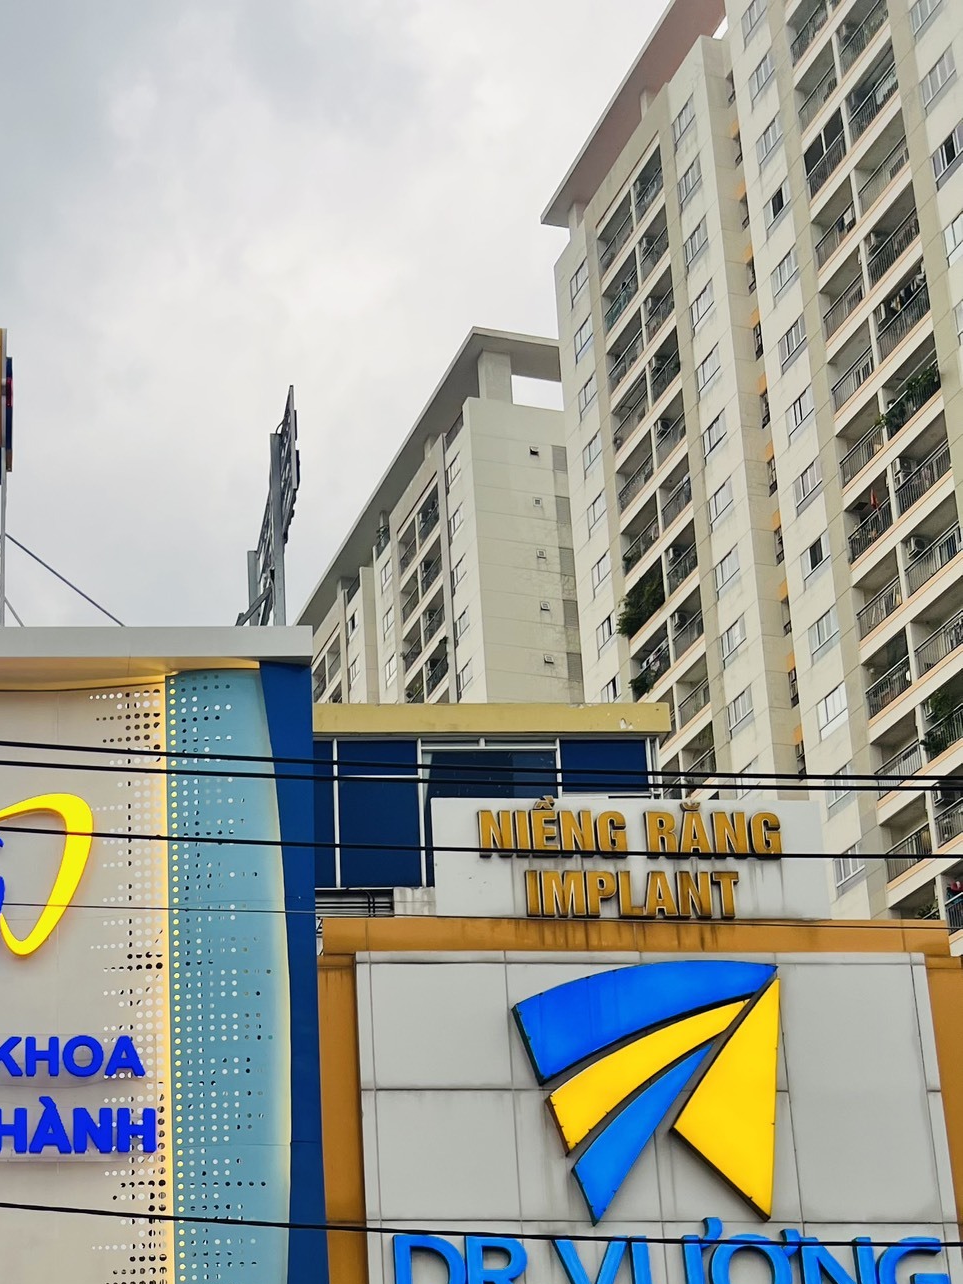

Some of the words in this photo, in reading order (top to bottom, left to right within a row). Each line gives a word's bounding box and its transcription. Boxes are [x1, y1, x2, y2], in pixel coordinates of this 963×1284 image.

[477, 796, 629, 858] NIỀNG
[644, 800, 783, 859] RĂNG
[525, 870, 739, 919] IMPLANT
